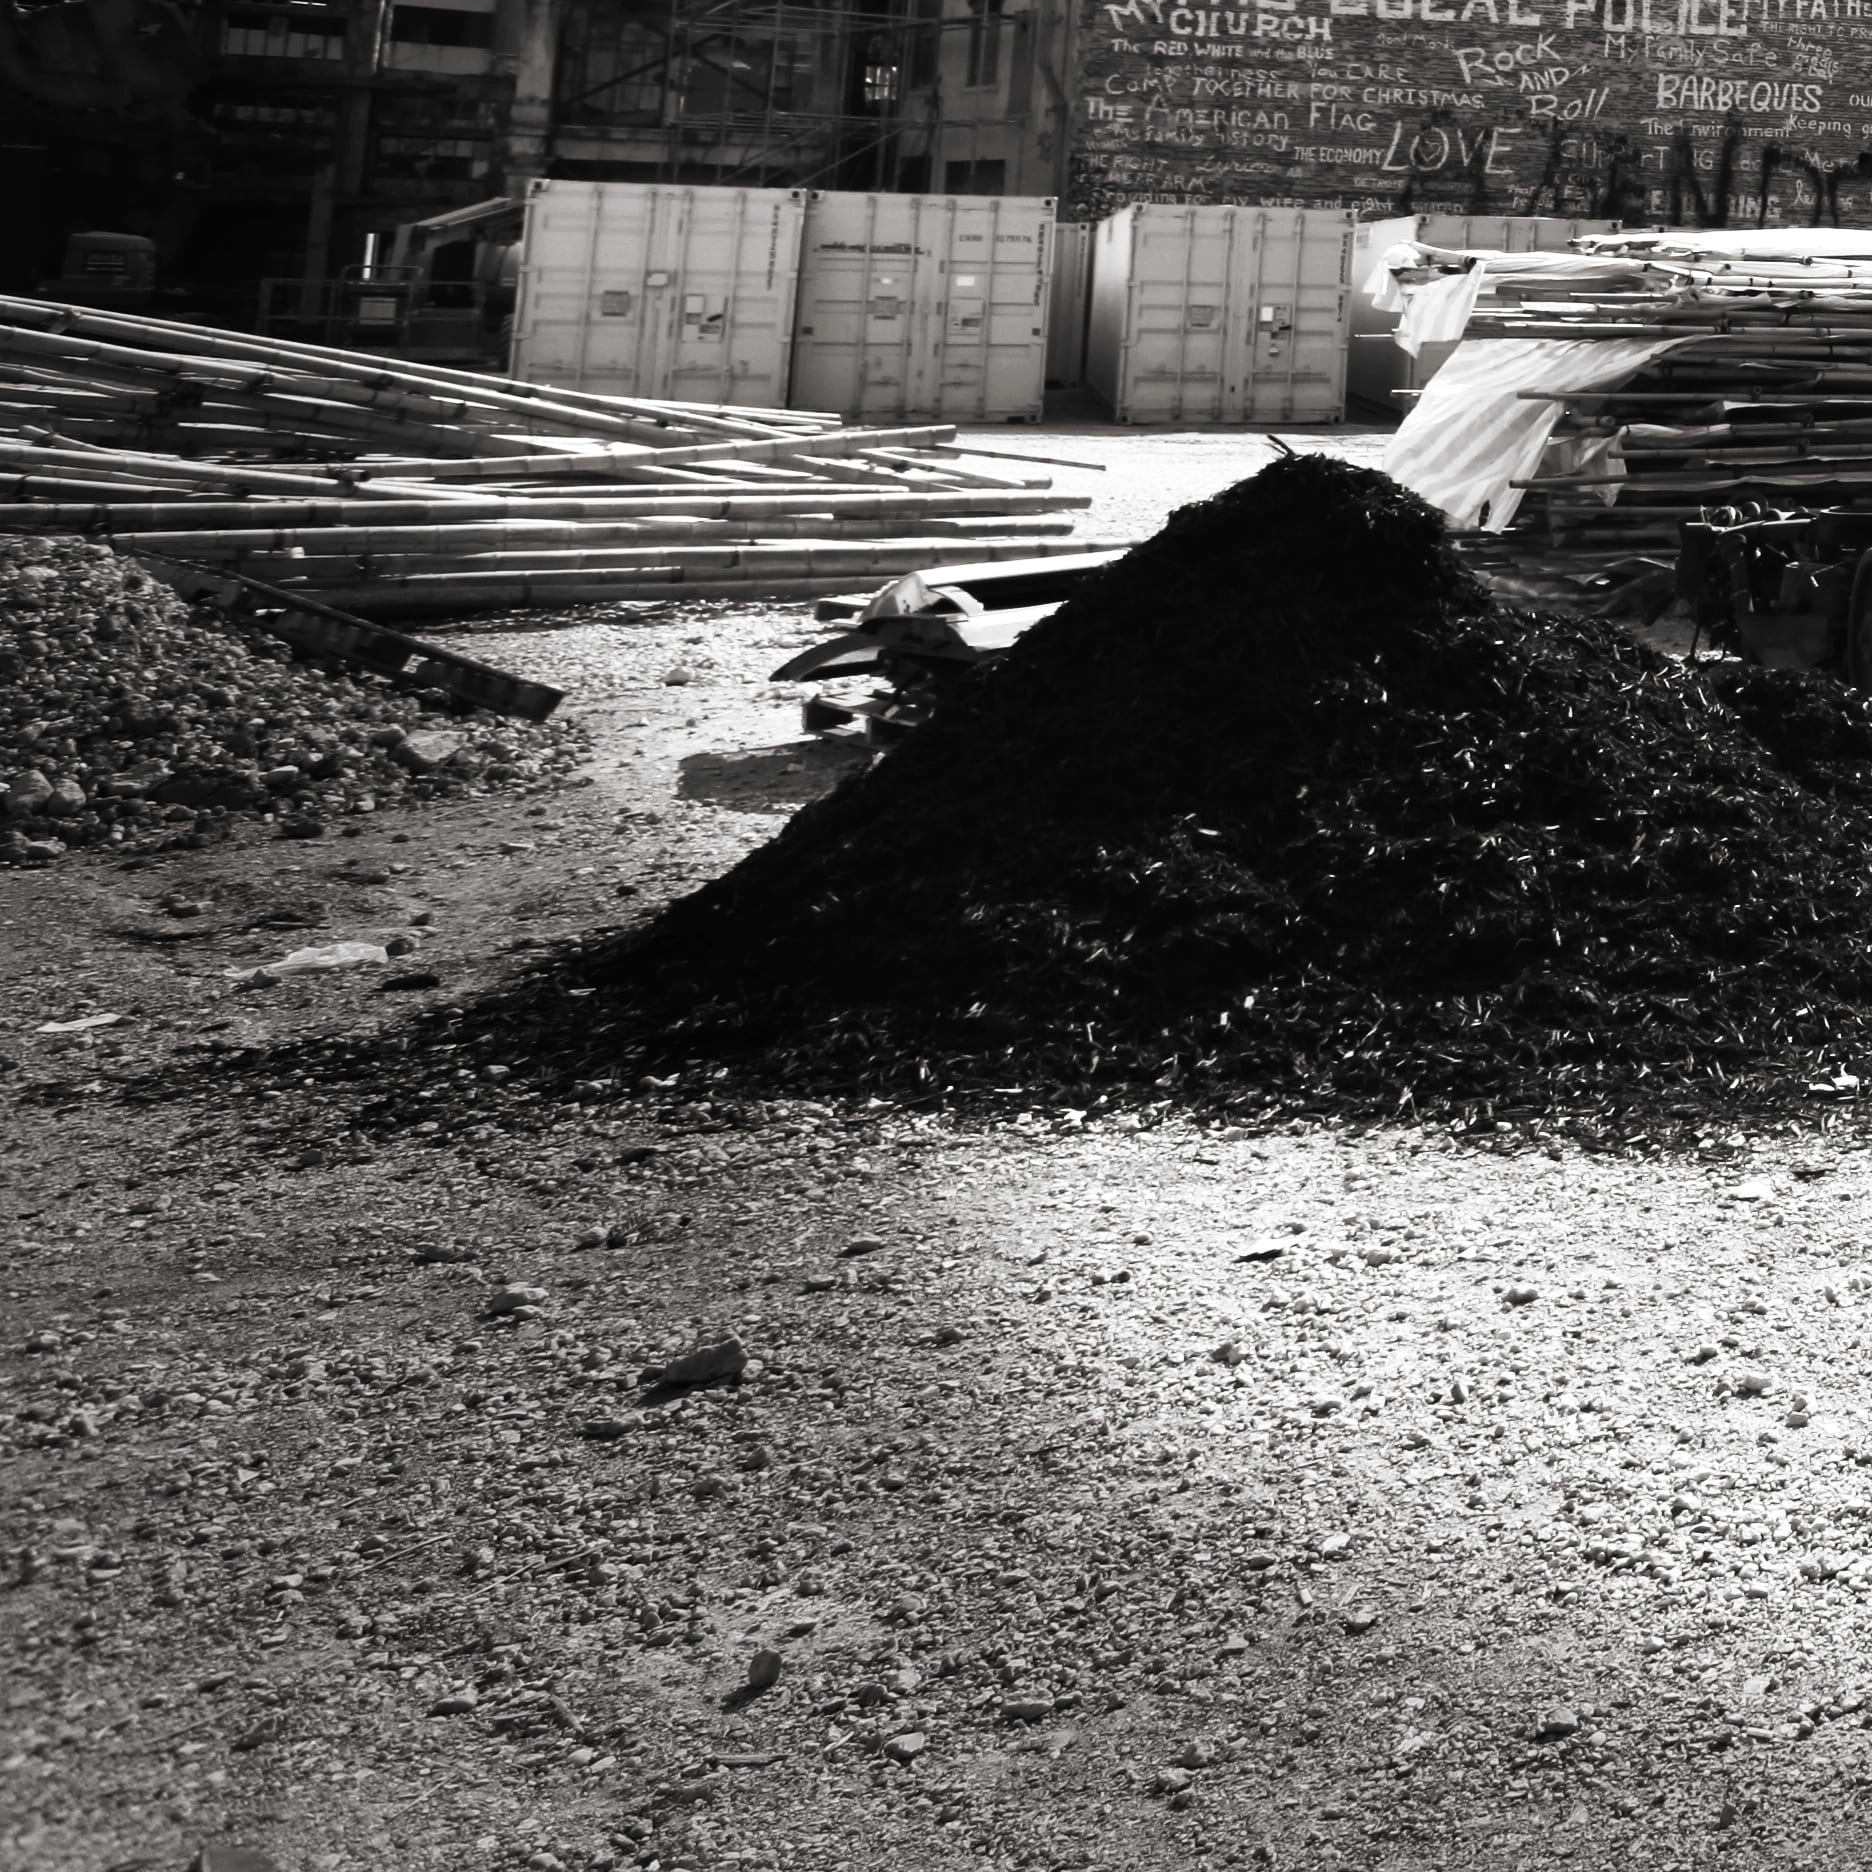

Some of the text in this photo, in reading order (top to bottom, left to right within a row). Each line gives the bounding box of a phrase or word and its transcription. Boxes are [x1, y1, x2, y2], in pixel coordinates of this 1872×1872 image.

[1169, 7, 1333, 42] CHURCH
[1111, 38, 1142, 55] The
[1153, 40, 1188, 58] RED
[1194, 42, 1244, 59] WHITE
[1297, 46, 1336, 61] BLUE
[1603, 32, 1778, 70] My Family Safe
[1191, 76, 1486, 110] TOGETHER FOR CHRISTMAS
[1519, 67, 1571, 92] AND
[1656, 73, 1824, 113] BARBEQUES
[1143, 93, 1290, 130] AMERICAN
[1526, 87, 1610, 121] Roll
[1640, 117, 1674, 137] The
[1788, 113, 1852, 139] Keeping
[1293, 145, 1385, 165] THE ECONOMY
[1381, 119, 1522, 174] LOVE
[1312, 194, 1395, 216] and eight
